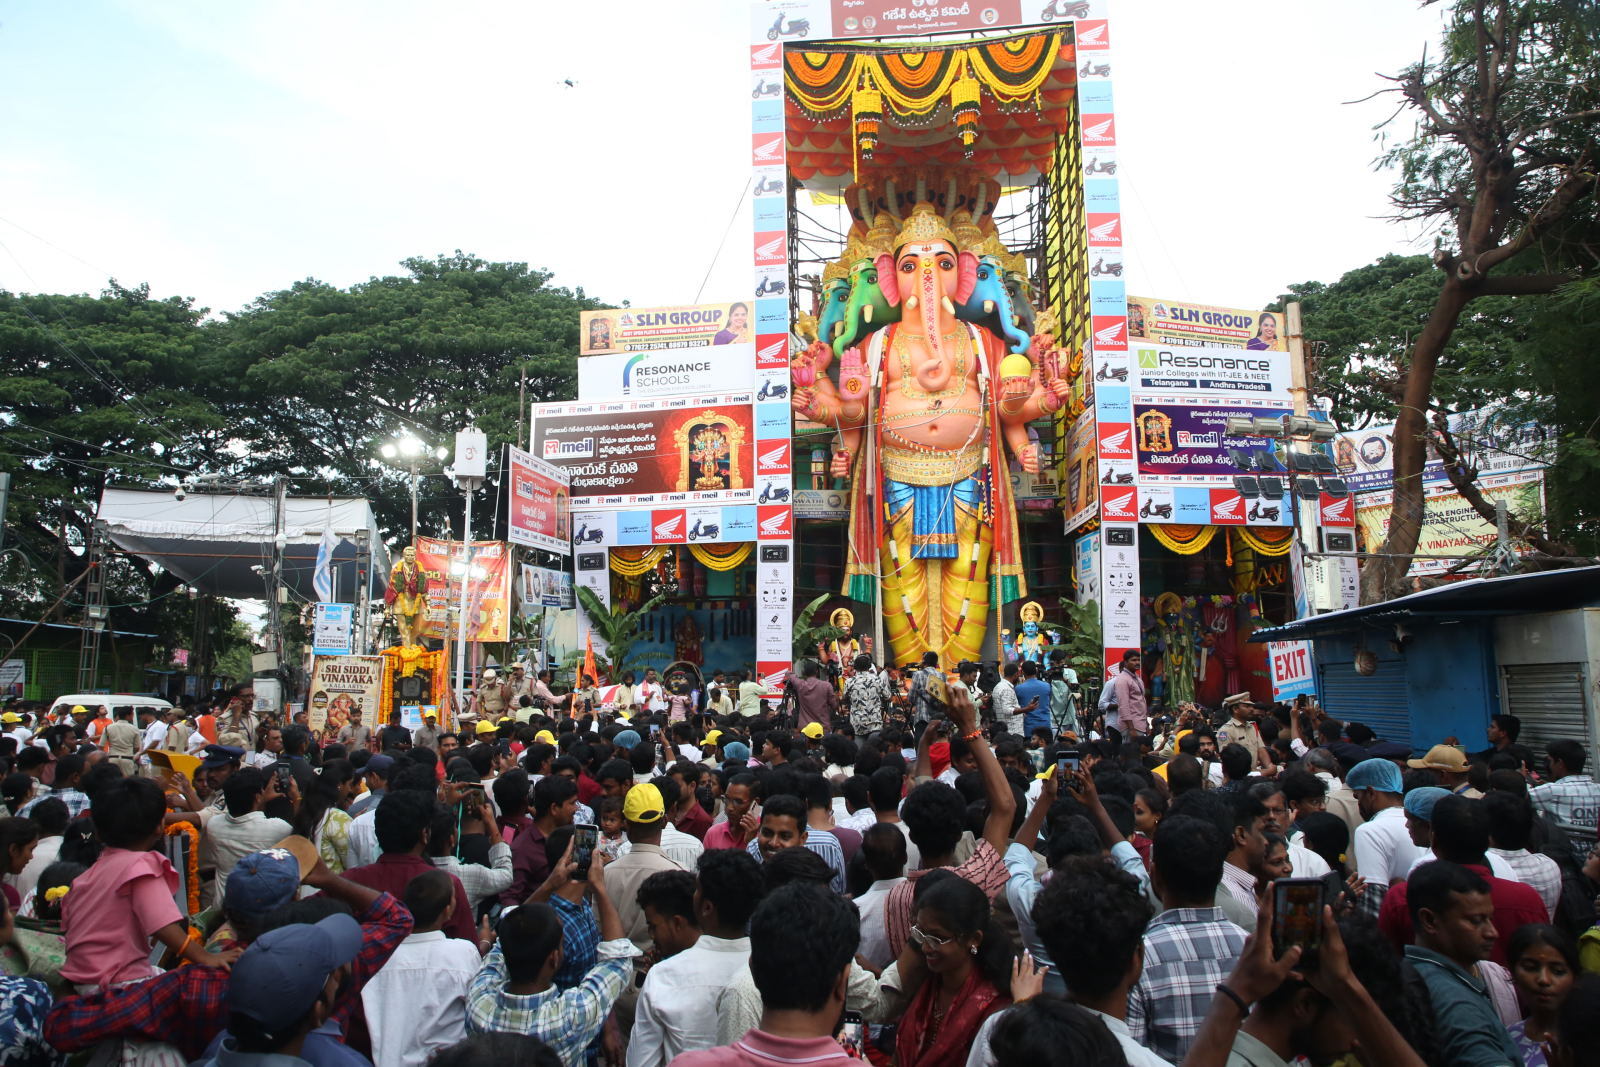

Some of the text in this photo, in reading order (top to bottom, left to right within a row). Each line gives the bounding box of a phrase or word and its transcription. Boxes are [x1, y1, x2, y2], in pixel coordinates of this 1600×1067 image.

[636, 310, 723, 326] SLN GROUP
[1170, 307, 1199, 322] SLN
[1202, 312, 1253, 329] GROUP
[1158, 352, 1270, 372] Resonance
[636, 362, 711, 376] RESONANCE
[1166, 370, 1199, 378] Colleges
[636, 375, 690, 388] SCHOOLS
[1150, 379, 1188, 388] Telangana
[1238, 383, 1266, 391] Pradesh
[1192, 432, 1217, 443] meil
[562, 439, 592, 453] meil
[1150, 454, 1189, 464] వినాయక
[1191, 454, 1213, 464] చవితి
[609, 462, 638, 474] చవితి
[571, 476, 624, 488] శుభాకాంక్షలు
[1494, 476, 1508, 484] meil
[1522, 473, 1537, 482] meil
[1446, 507, 1476, 516] ENGINE
[1427, 536, 1473, 550] VINAYAKA
[325, 665, 370, 675] SRI SIDDI
[1274, 648, 1306, 682] EXIT
[321, 674, 373, 684] VINAYAKA
[1571, 808, 1598, 820] ON
